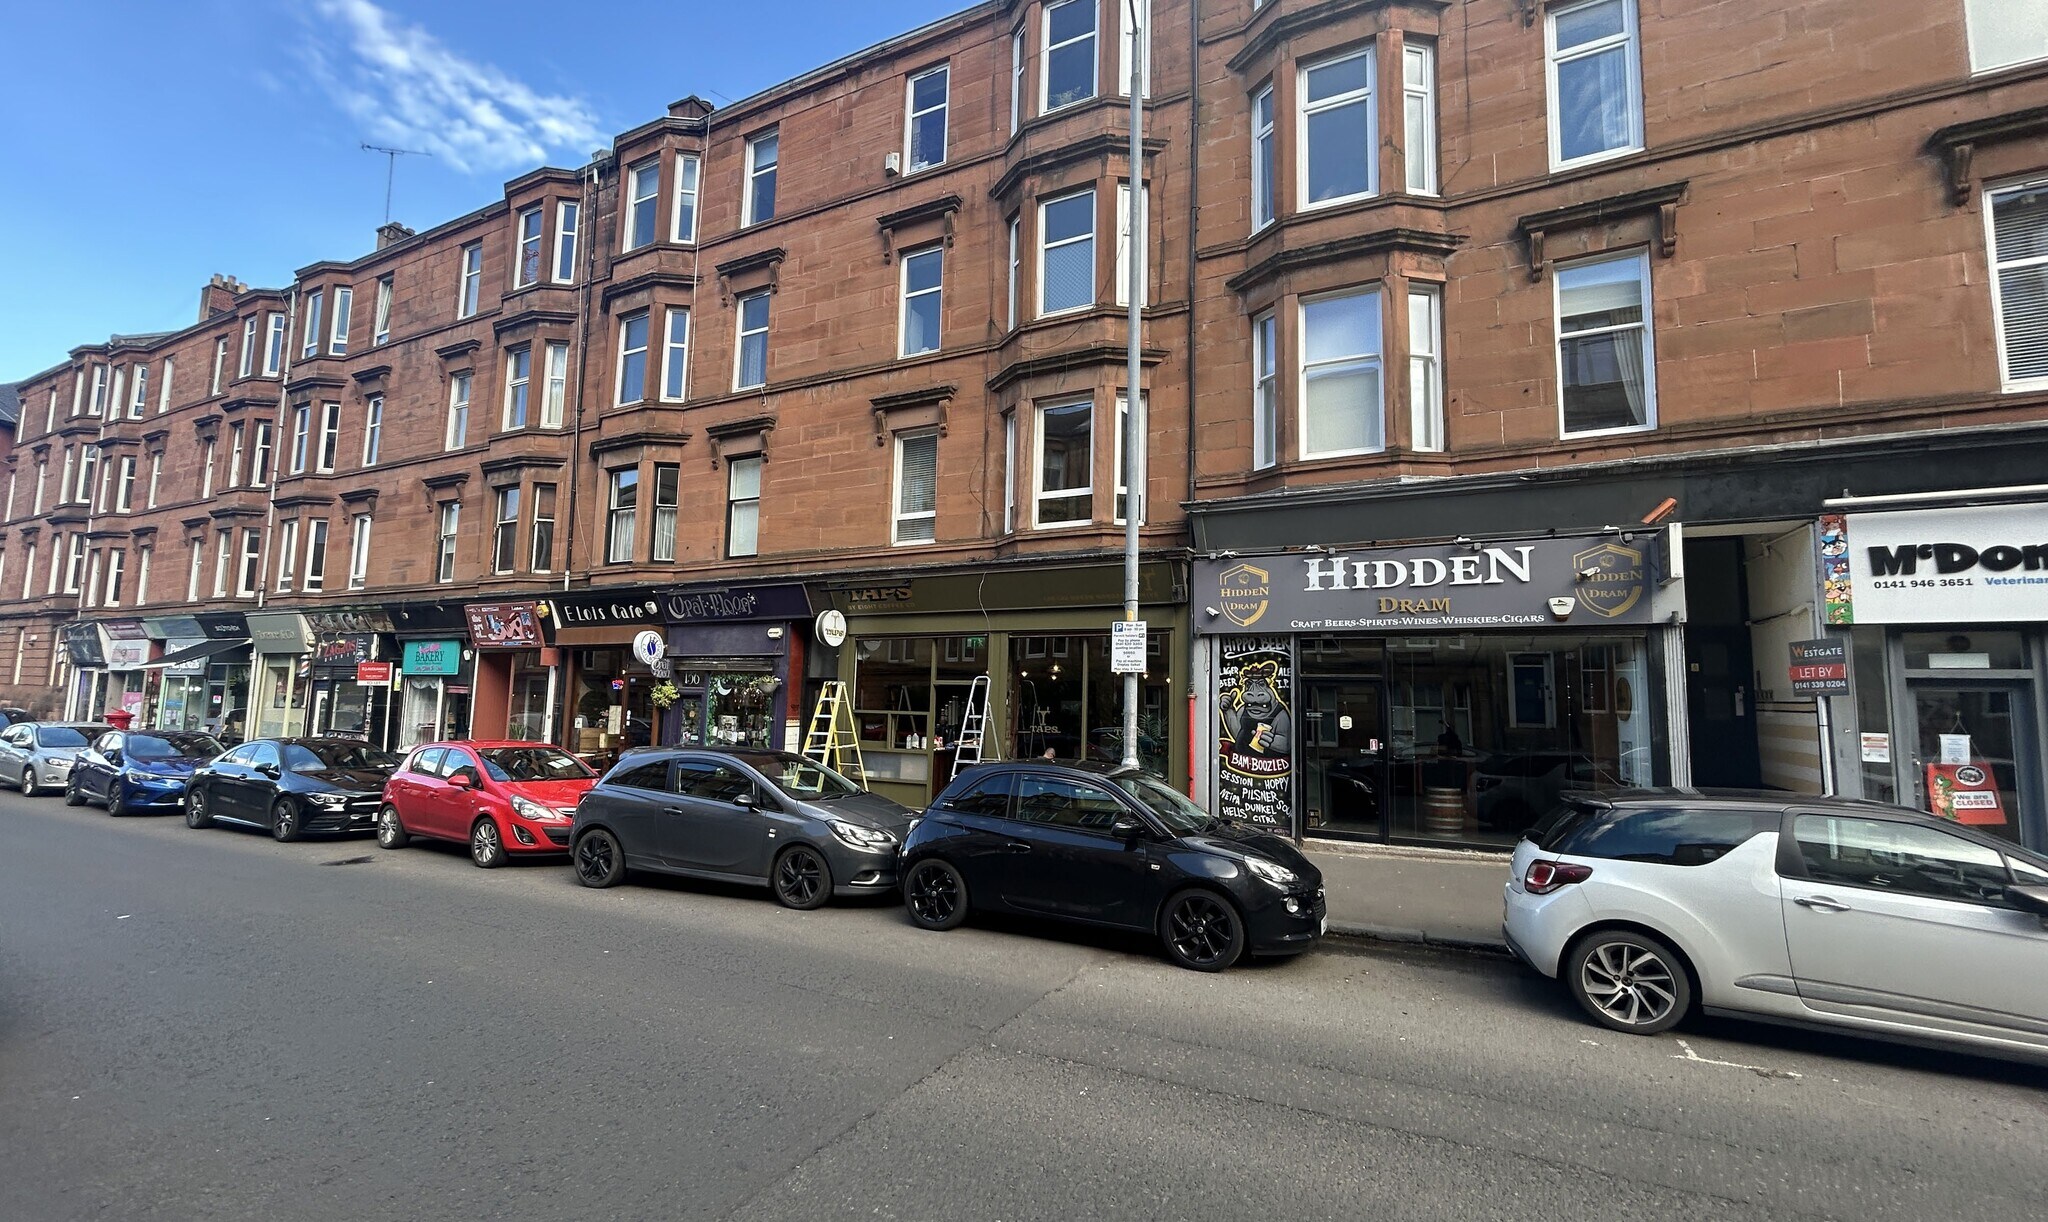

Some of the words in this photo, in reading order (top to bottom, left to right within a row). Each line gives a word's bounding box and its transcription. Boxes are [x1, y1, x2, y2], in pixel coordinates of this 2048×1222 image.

[1304, 546, 1534, 591] HIDDEN
[1874, 581, 1906, 589] 0141
[1910, 580, 1935, 588] 946
[1939, 579, 1973, 587] 3651
[850, 587, 913, 601] TAPS
[1221, 586, 1270, 597] HIDDEN
[1589, 590, 1627, 598] DRAM
[611, 604, 644, 619] Cafe
[1230, 602, 1258, 610] DRAM
[1379, 596, 1451, 614] DRAM
[1290, 620, 1322, 628] CRAFT
[1259, 637, 1291, 650] BEER
[415, 650, 445, 662] BAKERY
[1792, 645, 1842, 658] WESTGATE
[1220, 666, 1239, 676] LAGER
[1799, 668, 1815, 678] LET
[1818, 667, 1832, 677] BY
[1220, 678, 1237, 688] BEER
[1030, 725, 1058, 733] TAPS
[1231, 753, 1289, 772] BAM-BOOZLED
[1220, 770, 1253, 787] SESSION
[1264, 777, 1289, 792] HOPPY
[1242, 788, 1279, 802] PILSNER
[1222, 806, 1247, 819] HELLS
[1245, 802, 1277, 815] DUNKEL
[1276, 800, 1293, 817] SOU
